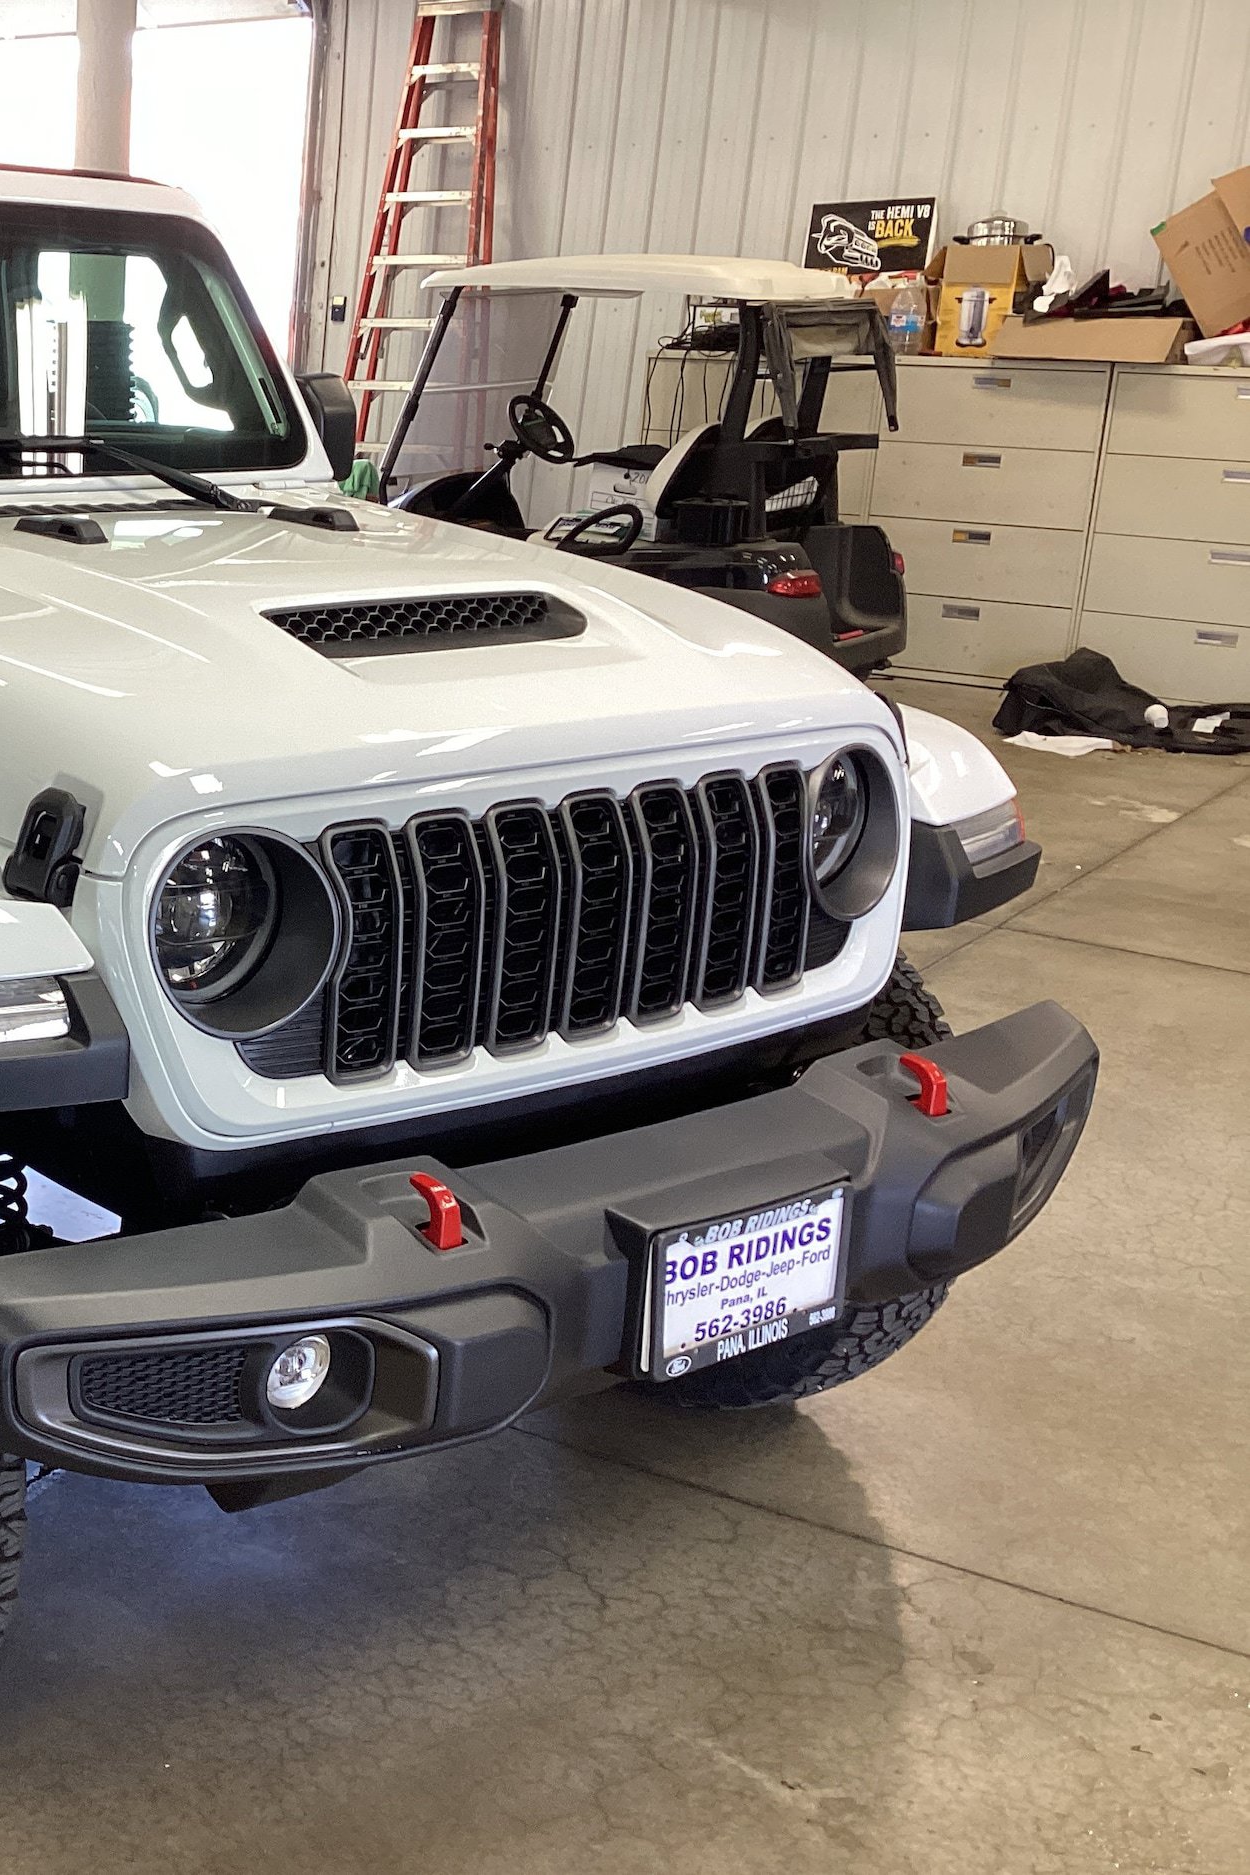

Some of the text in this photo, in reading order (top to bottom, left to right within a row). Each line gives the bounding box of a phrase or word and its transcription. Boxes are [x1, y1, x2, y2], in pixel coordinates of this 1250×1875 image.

[868, 219, 915, 239] IS BACK
[871, 204, 931, 220] THE HEMI V8
[704, 1199, 812, 1245] BOB RIDINGS
[665, 1217, 831, 1285] BOB RIDINGS
[666, 1244, 831, 1307] hrysler-Dodge-Jeep-Ford
[721, 1286, 768, 1310] Pana, IL
[694, 1296, 787, 1342] 562-3986
[749, 1317, 789, 1350] ILLINOIS
